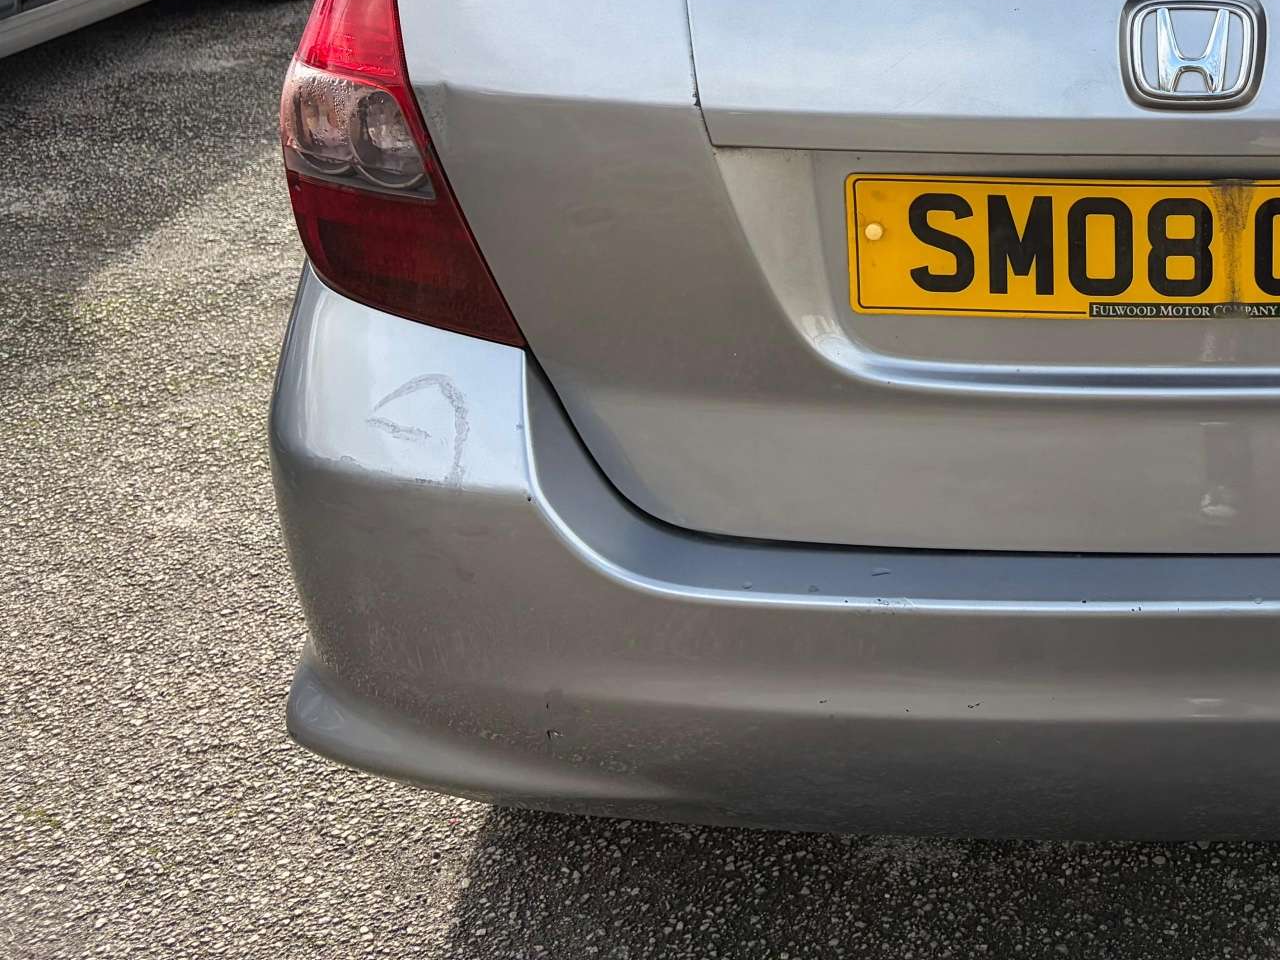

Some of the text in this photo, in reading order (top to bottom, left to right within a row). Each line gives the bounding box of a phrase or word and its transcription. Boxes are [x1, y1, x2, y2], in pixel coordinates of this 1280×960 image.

[907, 192, 1214, 296] SM08
[1092, 304, 1156, 316] FULWOOD
[1159, 305, 1210, 316] MOTOR
